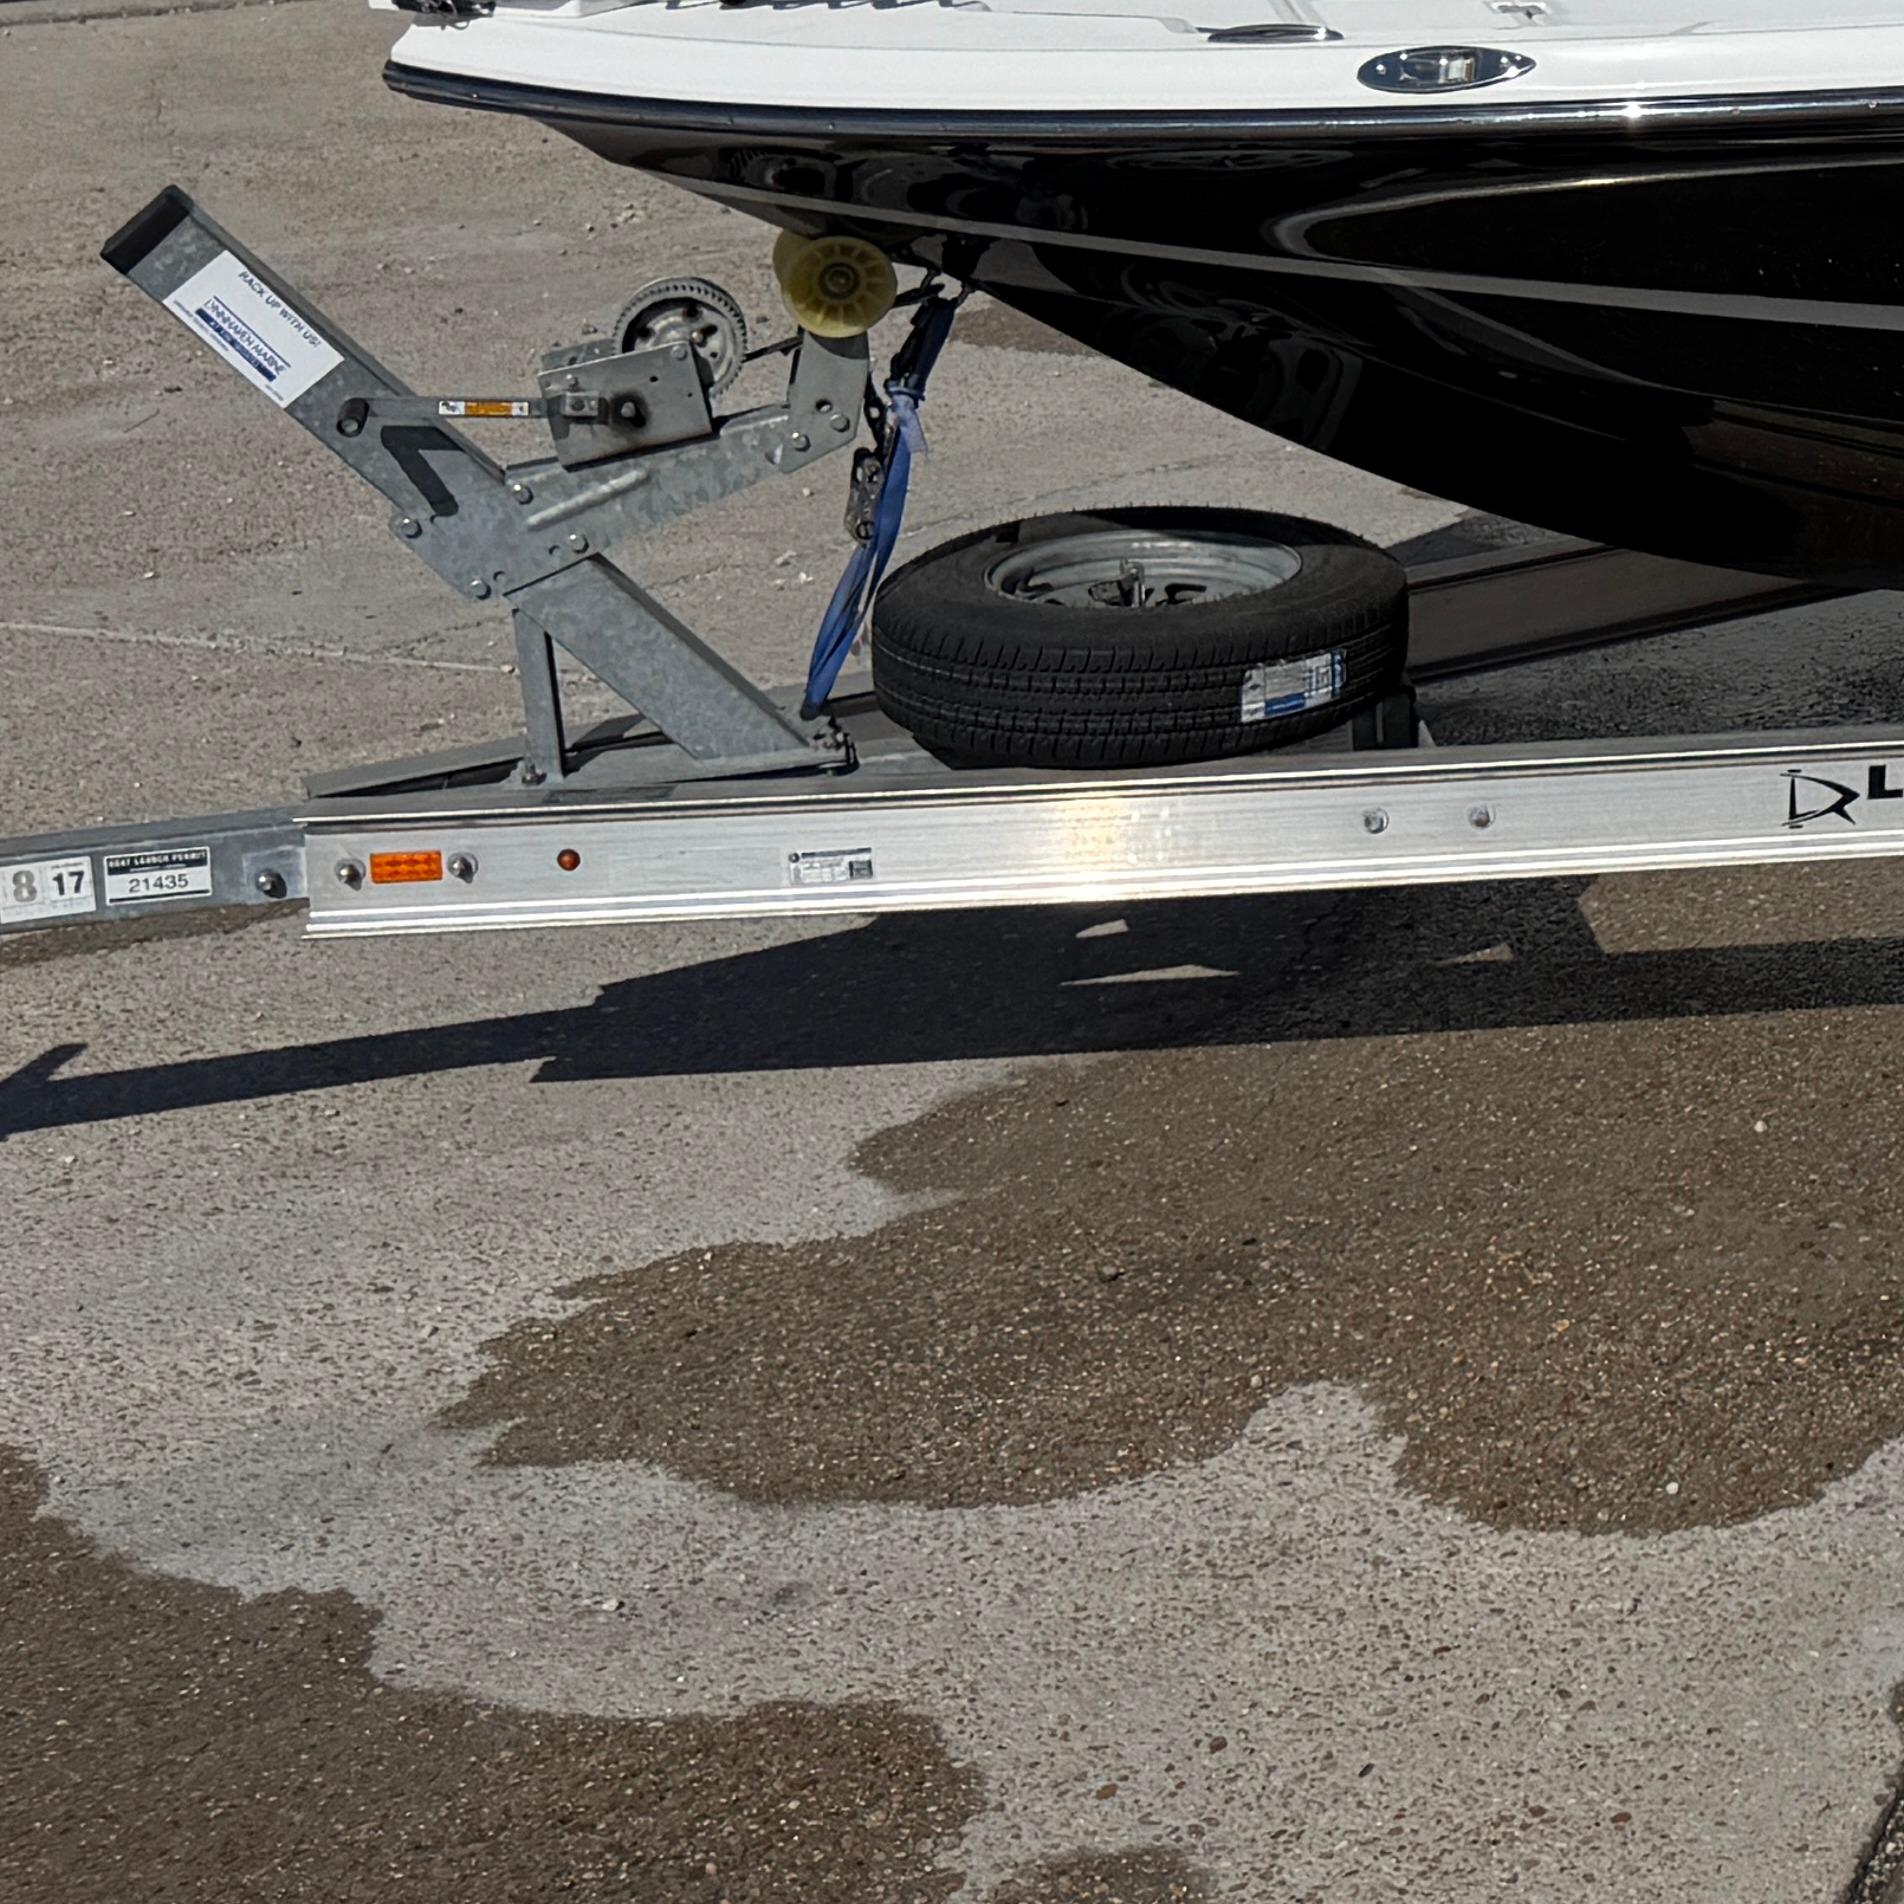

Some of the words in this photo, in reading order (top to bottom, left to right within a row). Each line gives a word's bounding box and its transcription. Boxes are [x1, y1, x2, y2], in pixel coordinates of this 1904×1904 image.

[265, 295, 281, 309] UP
[279, 309, 303, 333] WITH
[251, 342, 286, 375] MARINE
[13, 871, 37, 902] 8
[52, 871, 84, 896] 17
[128, 873, 189, 893] 21435
